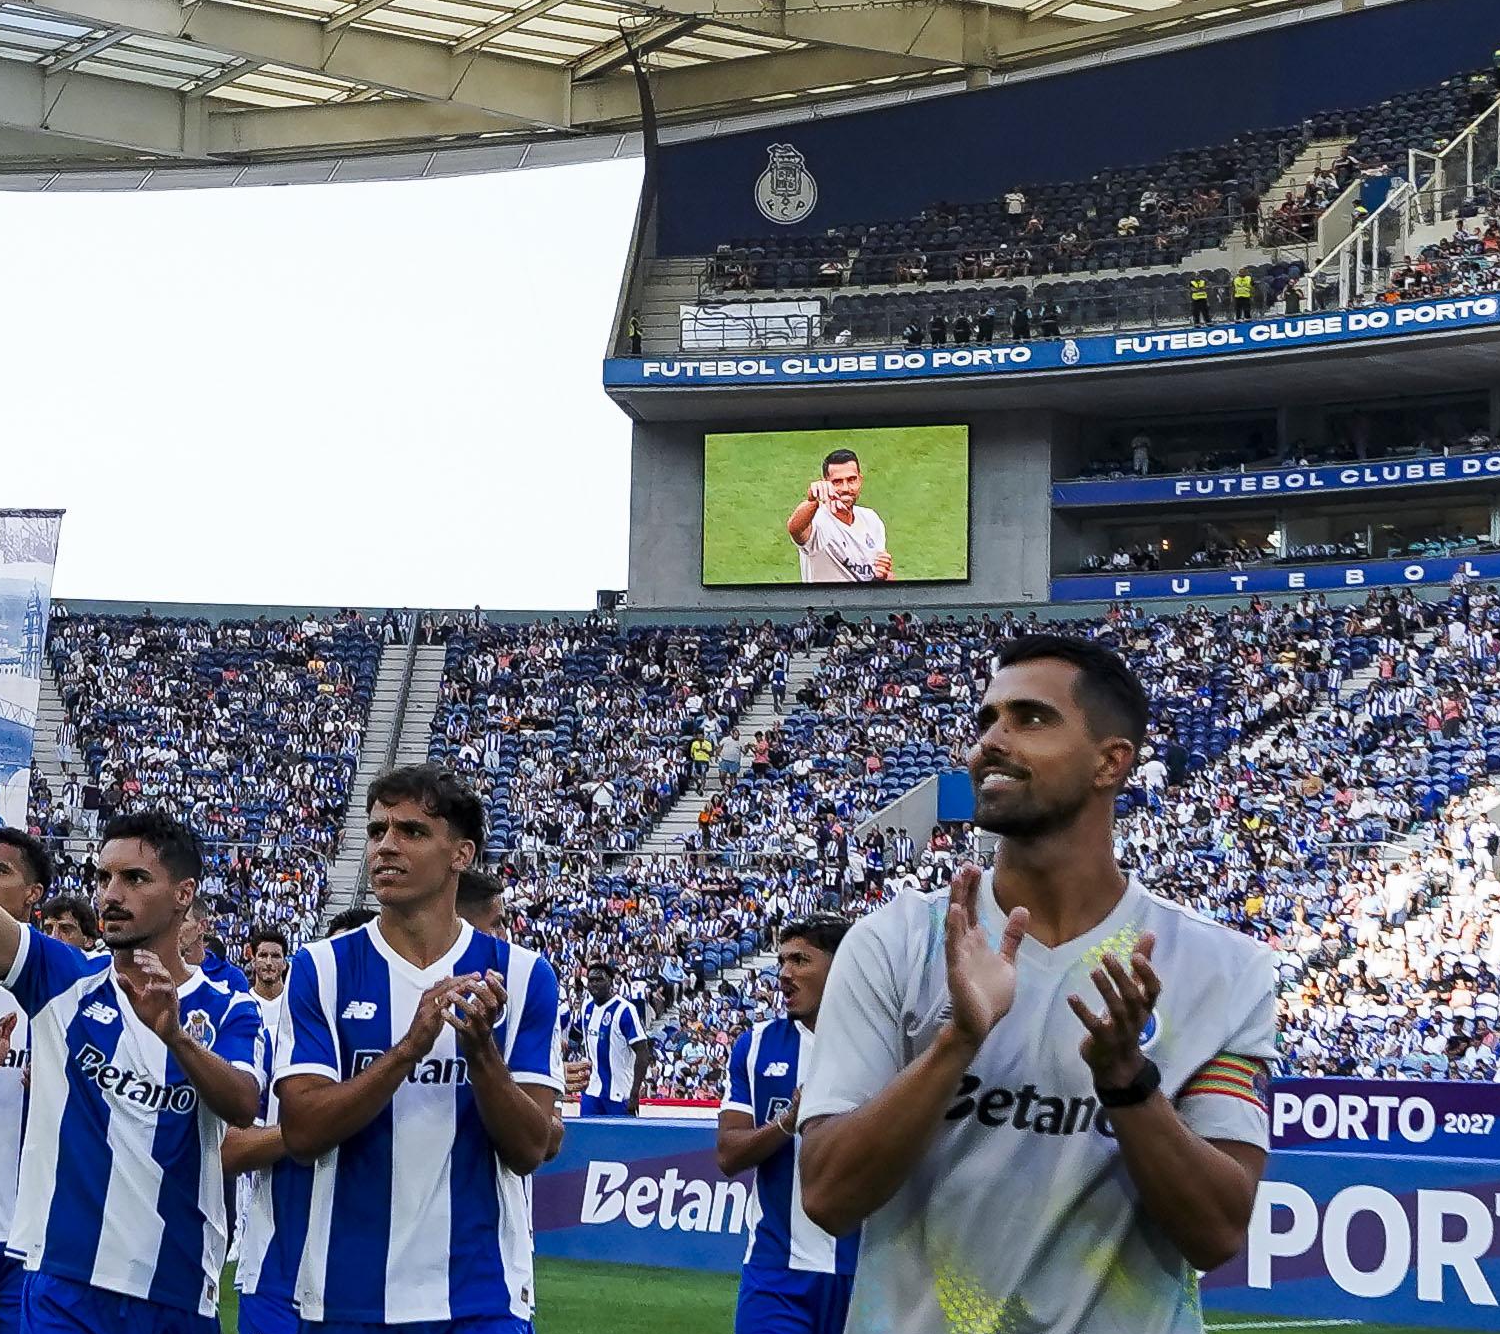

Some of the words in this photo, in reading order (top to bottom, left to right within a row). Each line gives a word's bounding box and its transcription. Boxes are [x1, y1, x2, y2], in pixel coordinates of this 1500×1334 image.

[1115, 329, 1244, 356] FUTEBOL
[1249, 316, 1343, 343] CLUBE
[1348, 310, 1390, 332] DO
[1395, 297, 1498, 328] PORTO
[642, 359, 768, 378] FUTEBOL
[780, 355, 880, 375] CLUBE
[884, 351, 932, 369] DO
[938, 346, 1032, 368] PORTO
[1175, 472, 1325, 497] FUTEBOL
[1340, 459, 1446, 485] CLUBE
[1114, 561, 1481, 597] FUTEBOL
[74, 1042, 199, 1115] Betano
[1272, 1093, 1436, 1144] PORTO
[1443, 1112, 1496, 1136] 2027
